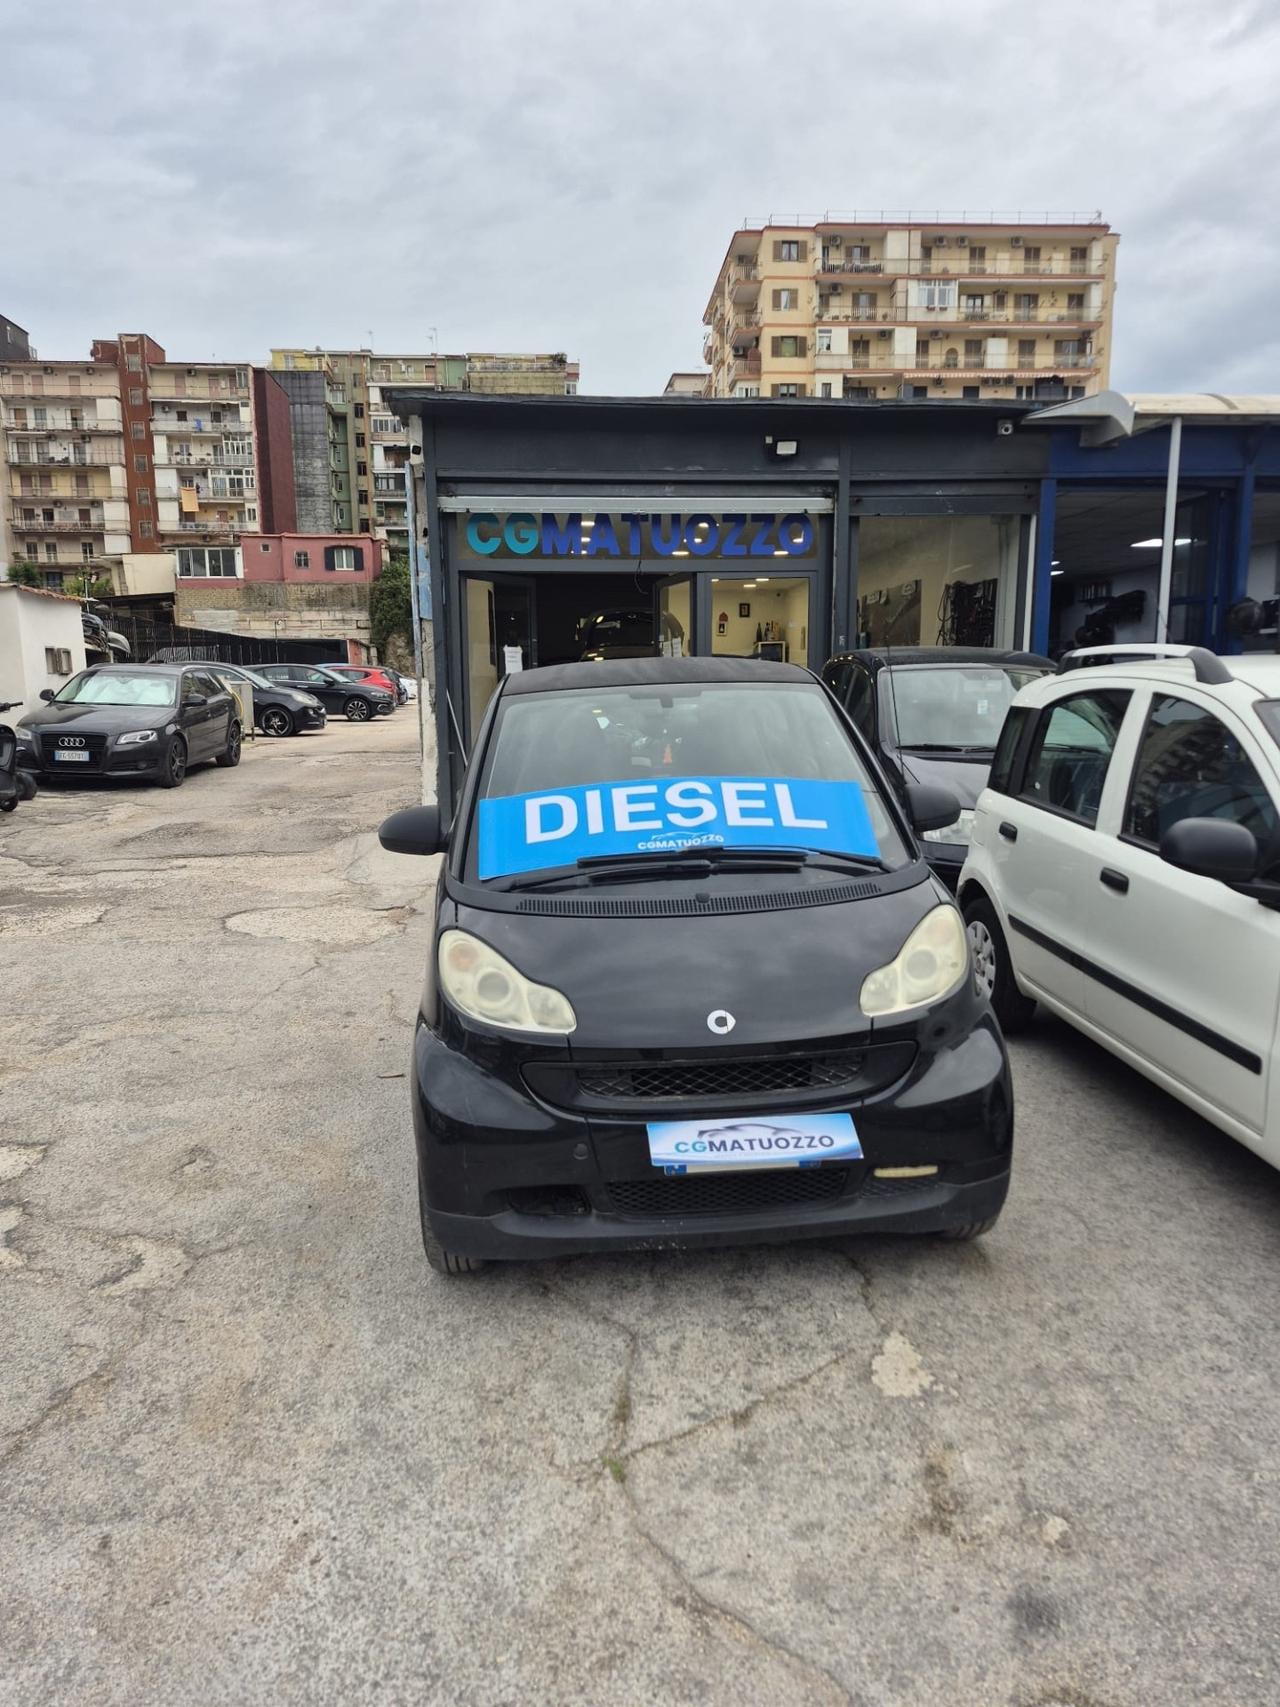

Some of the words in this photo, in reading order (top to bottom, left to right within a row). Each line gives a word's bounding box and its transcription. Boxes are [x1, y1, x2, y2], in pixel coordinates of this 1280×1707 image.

[466, 512, 814, 556] CGMATUOZZO
[525, 781, 828, 844] DIESEL
[637, 834, 724, 850] CGMATUOZZO
[674, 1135, 835, 1153] CGMATUOZZO
